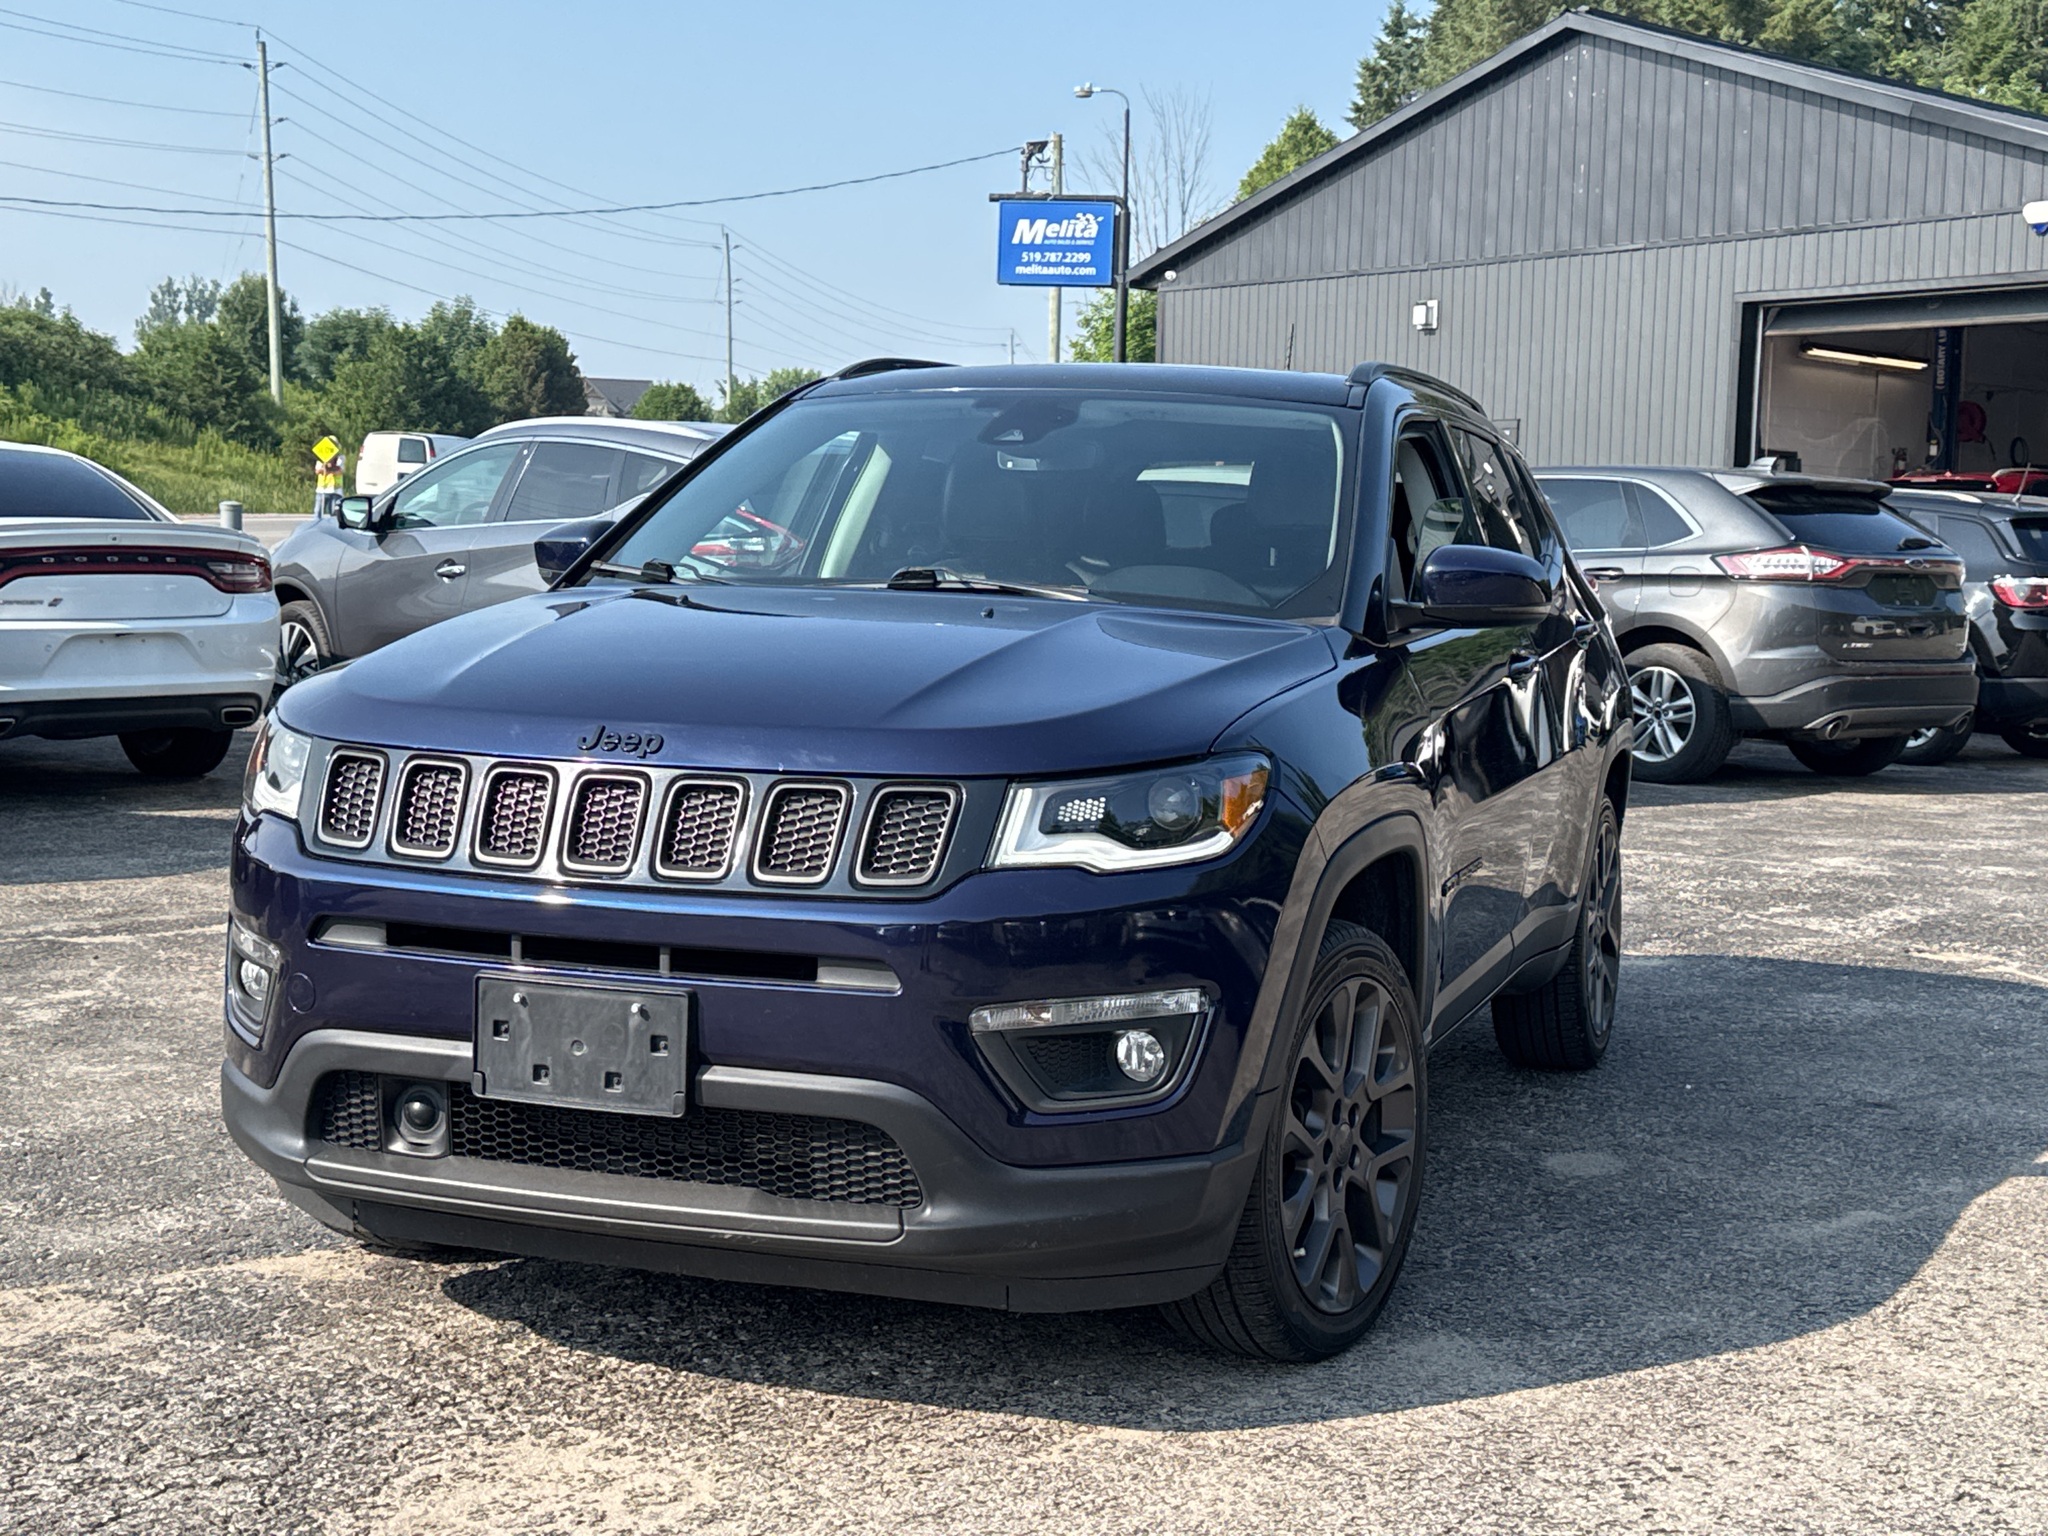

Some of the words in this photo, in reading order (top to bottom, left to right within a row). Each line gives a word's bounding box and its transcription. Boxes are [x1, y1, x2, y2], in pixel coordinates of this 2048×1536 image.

[1011, 216, 1099, 245] Melita
[1021, 251, 1091, 263] 519.787.2299
[1015, 263, 1096, 276] melitaauto.com
[577, 724, 664, 759] Jeep
